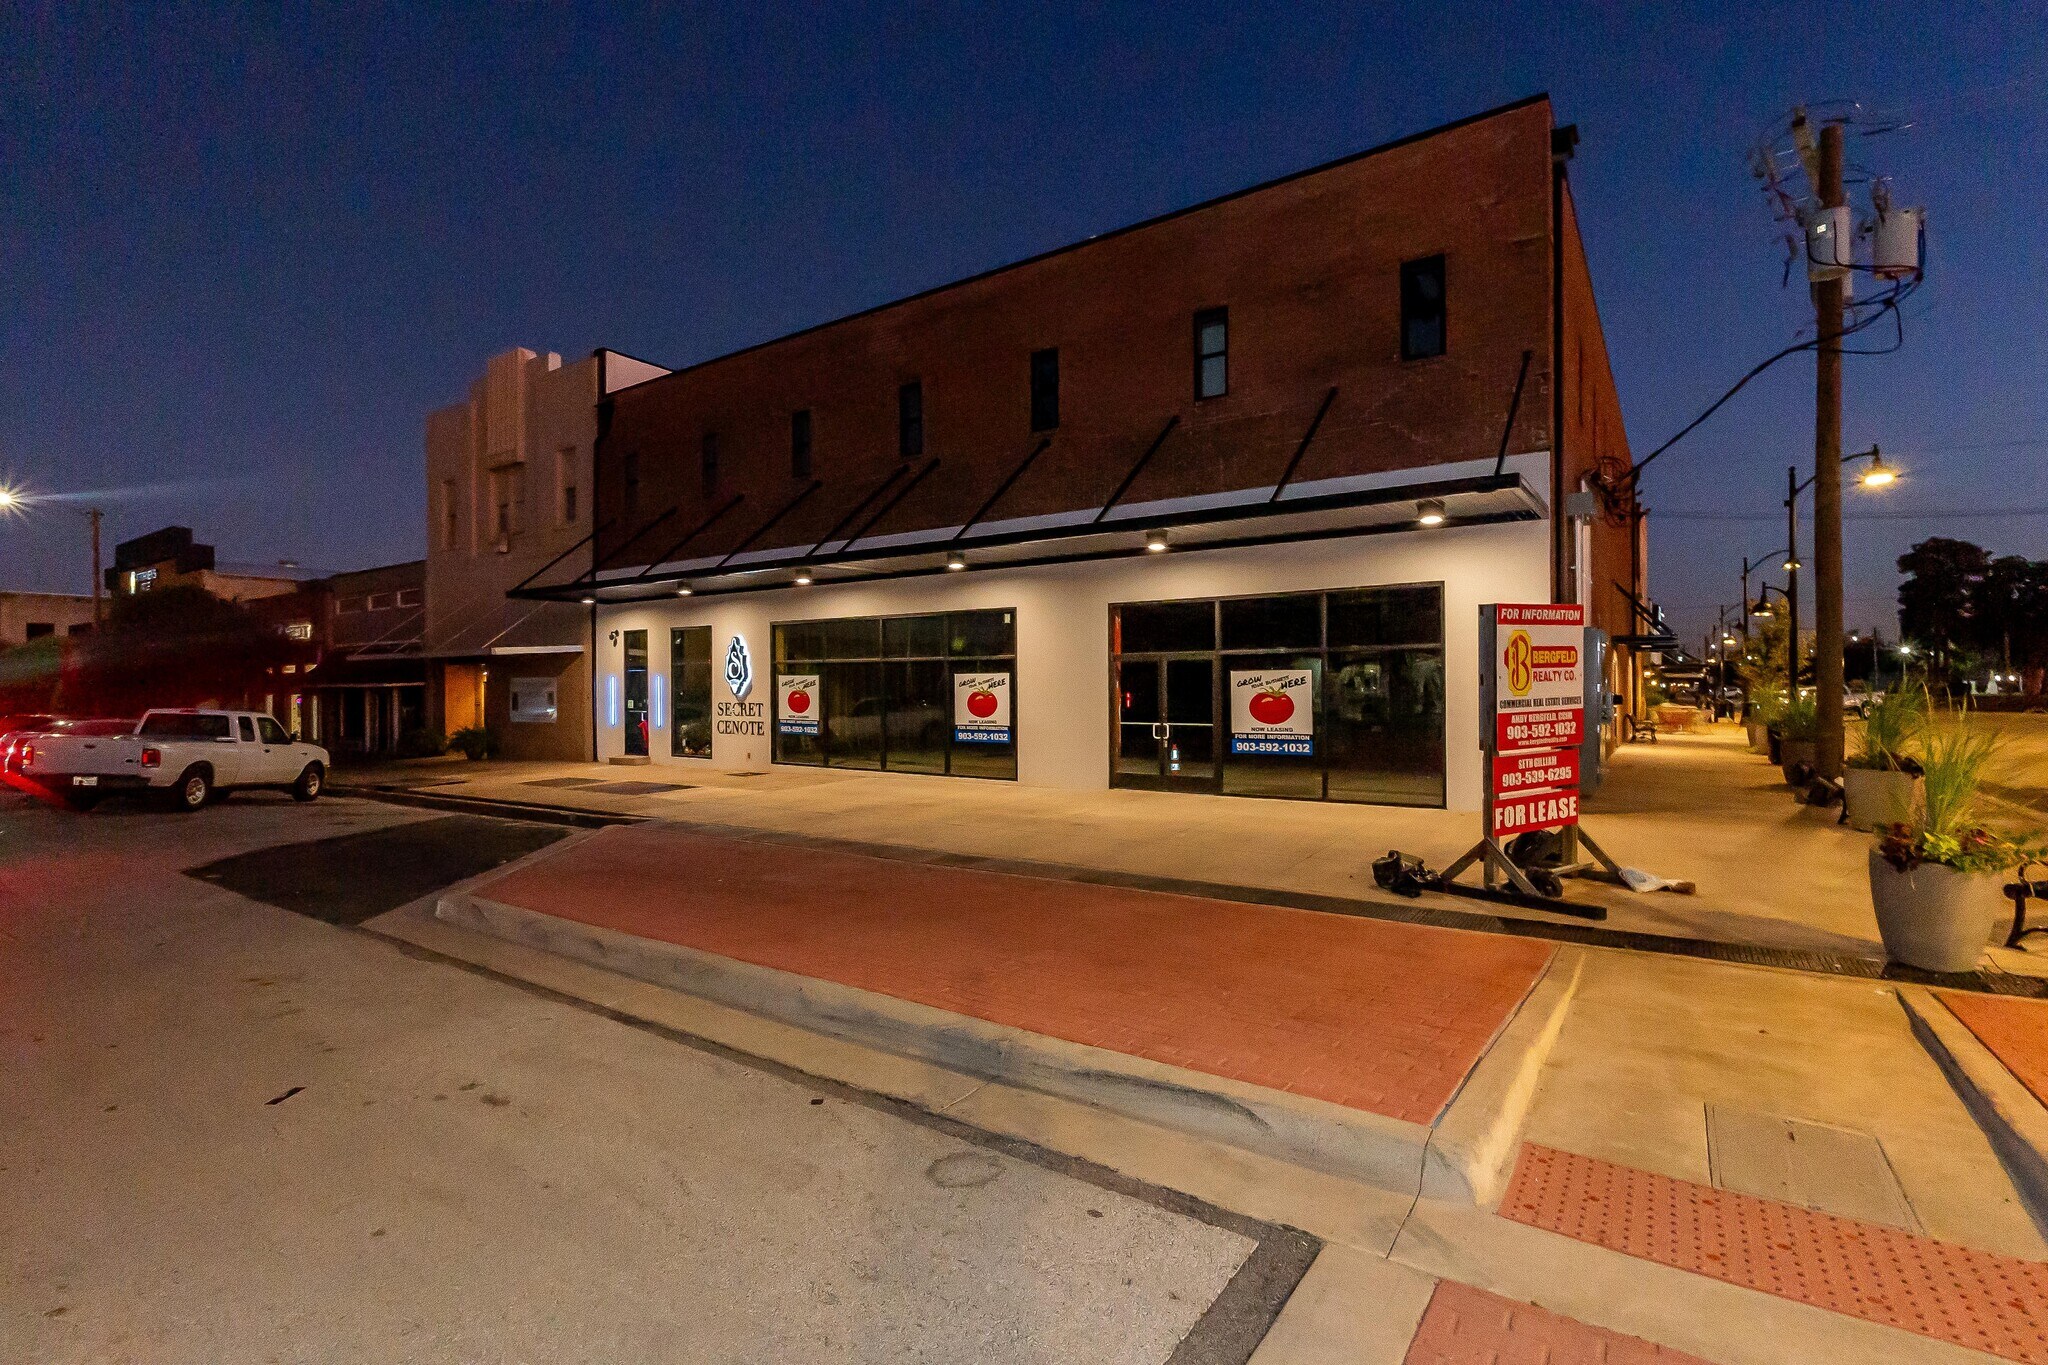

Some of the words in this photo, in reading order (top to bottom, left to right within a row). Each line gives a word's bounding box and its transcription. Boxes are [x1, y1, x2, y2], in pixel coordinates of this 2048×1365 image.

[1501, 608, 1519, 619] FOR
[1522, 609, 1580, 620] INFORMATION
[1533, 650, 1576, 663] BERGFELD
[1237, 675, 1262, 688] GROW
[1281, 676, 1307, 689] HERE
[1533, 670, 1562, 682] REALTY
[1564, 670, 1576, 681] CO.
[988, 678, 1006, 689] HERE
[717, 702, 764, 717] SECRET
[717, 720, 765, 736] CENOTE
[1507, 721, 1576, 740] 903-592-1032
[958, 732, 1008, 740] 903-592-1032
[1236, 742, 1310, 753] 903-592-1032
[1502, 766, 1572, 787] 903-539-6295
[1495, 804, 1526, 830] FOR
[1530, 796, 1577, 823] LEASE
